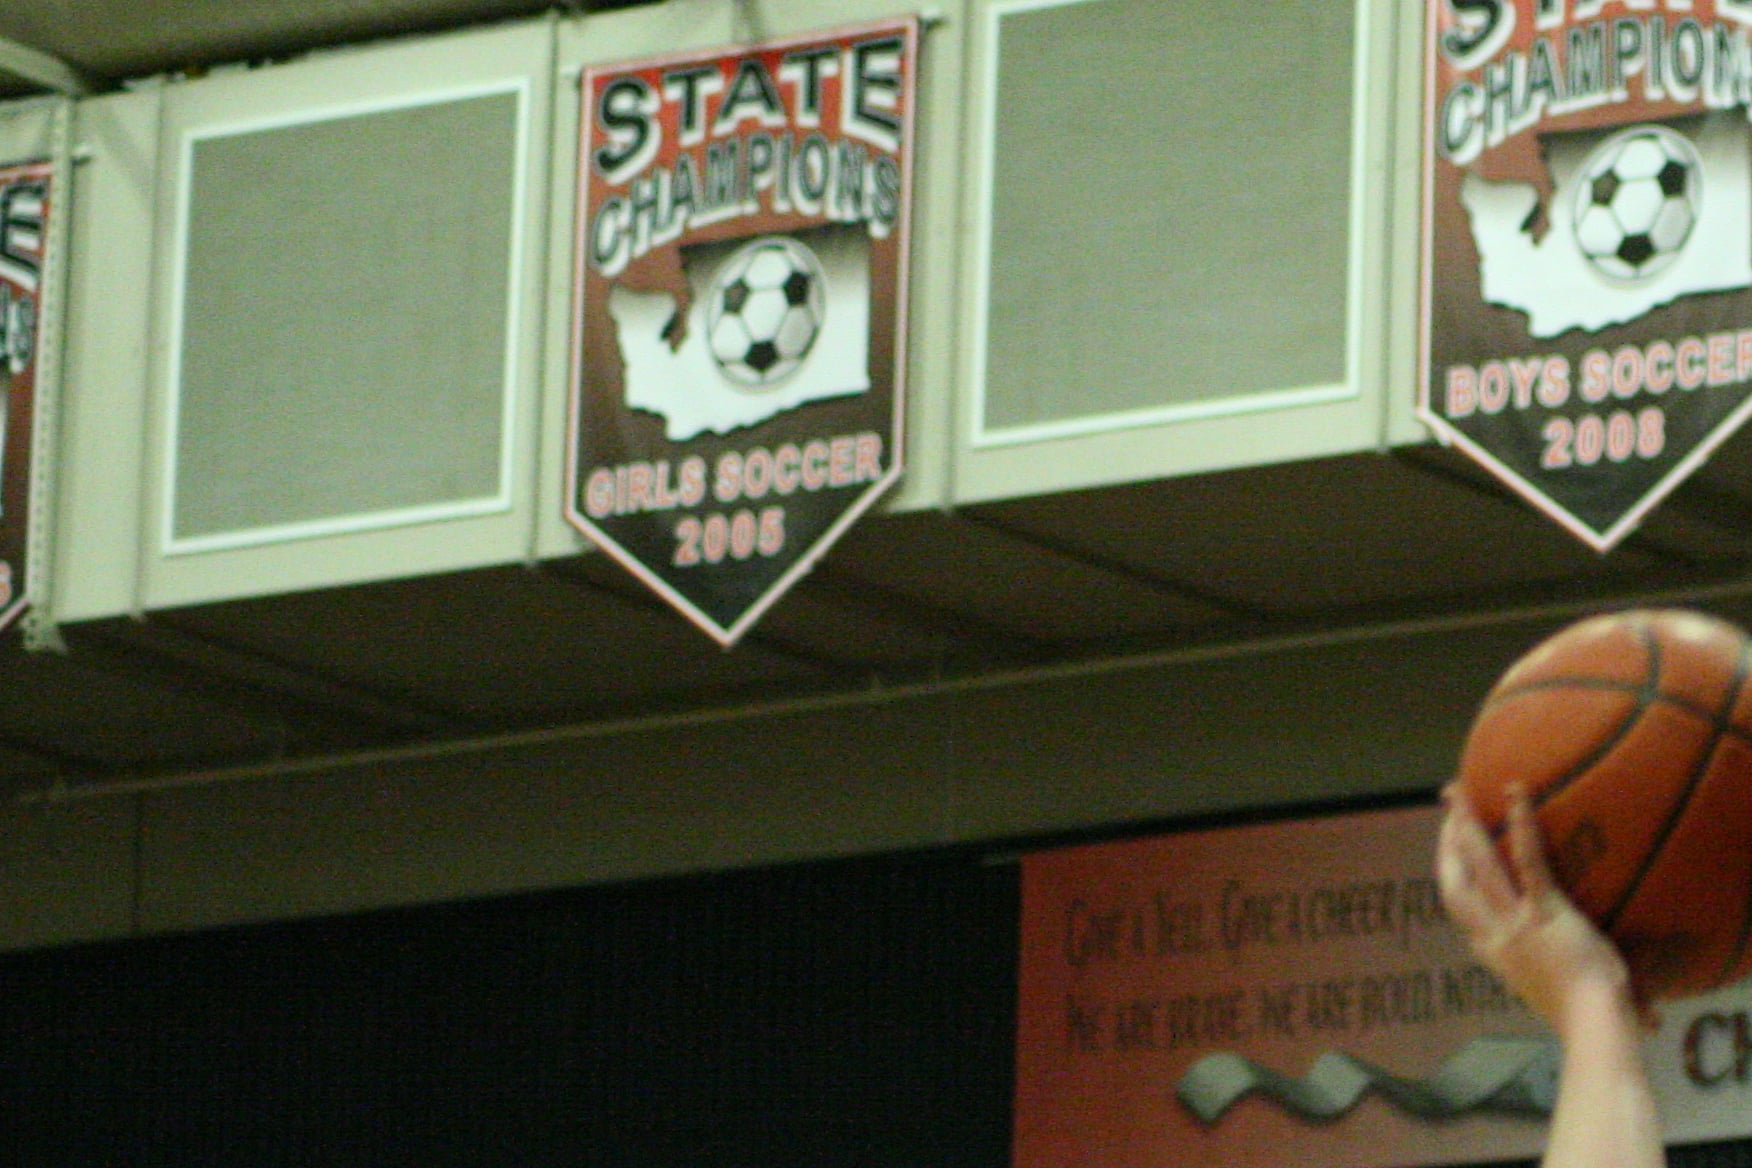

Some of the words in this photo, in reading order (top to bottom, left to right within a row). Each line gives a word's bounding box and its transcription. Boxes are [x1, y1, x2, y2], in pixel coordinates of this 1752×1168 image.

[594, 38, 903, 185] STATE
[592, 130, 900, 277] CHAMPIONS
[1446, 358, 1571, 418] BOYS
[584, 461, 706, 519] GIRLS
[715, 436, 884, 502] SOCCER
[1541, 410, 1666, 469] 2008
